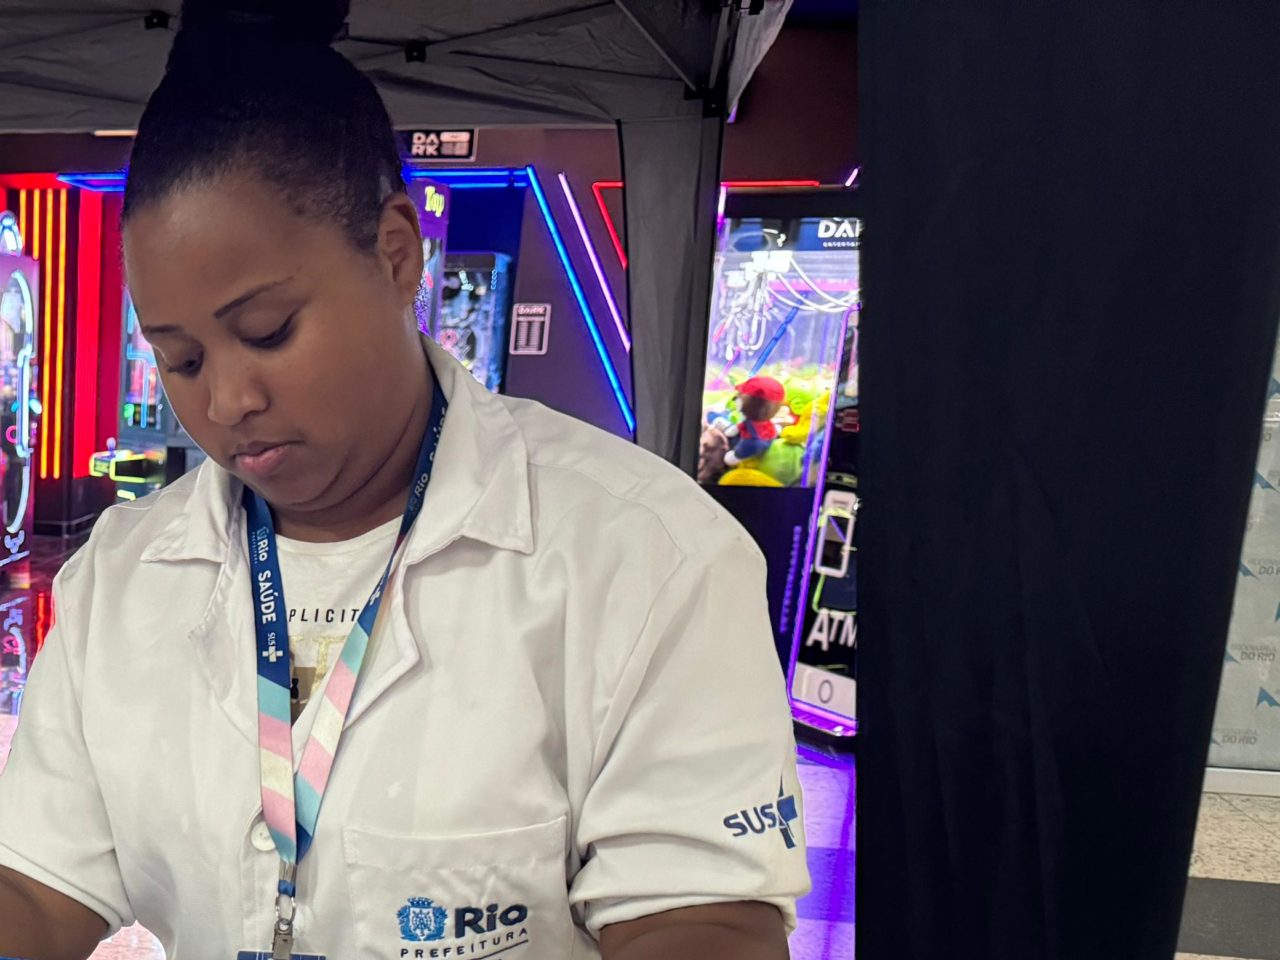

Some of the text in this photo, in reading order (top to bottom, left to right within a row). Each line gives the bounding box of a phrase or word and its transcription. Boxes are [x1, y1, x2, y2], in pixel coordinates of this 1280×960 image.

[257, 539, 268, 561] Rio
[258, 570, 278, 624] SAÚDE
[289, 608, 360, 622] PLICIT
[267, 632, 276, 645] SUS
[723, 803, 777, 837] SUS
[454, 902, 528, 939] Rio
[400, 927, 529, 959] PREFEITURA
